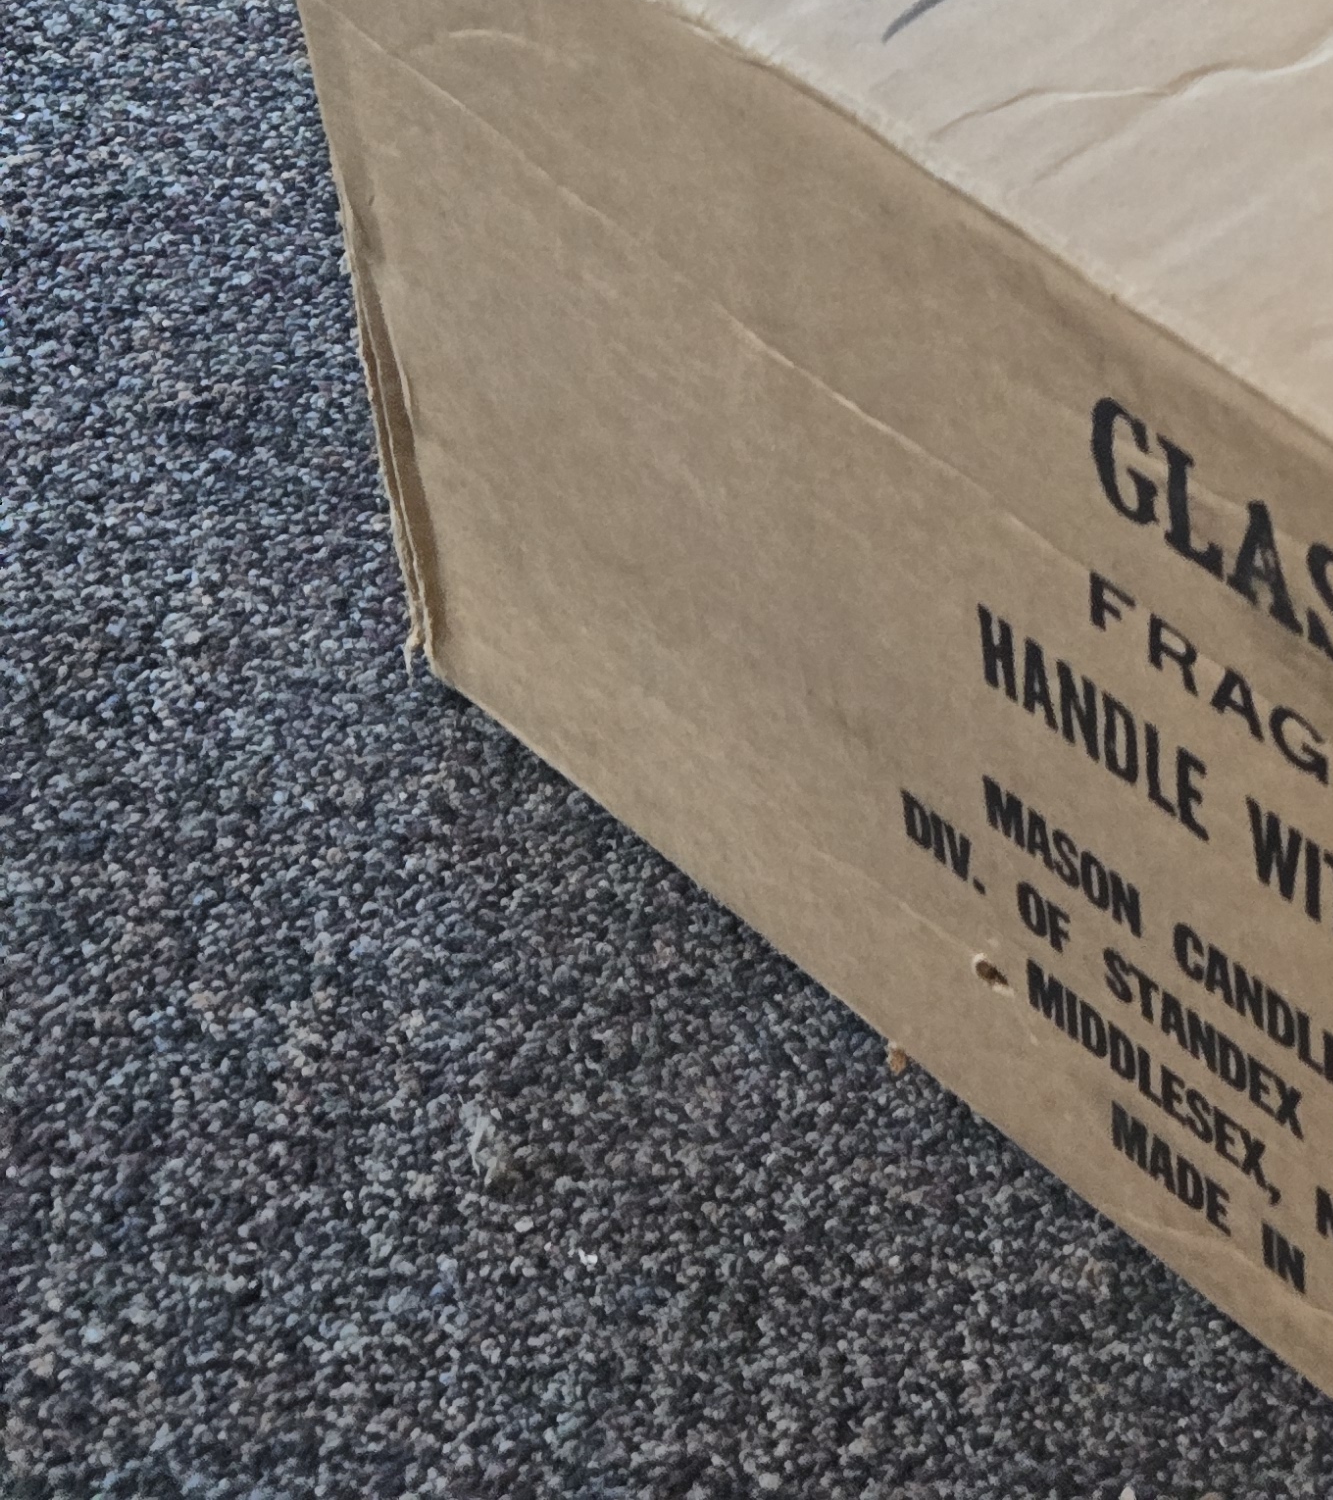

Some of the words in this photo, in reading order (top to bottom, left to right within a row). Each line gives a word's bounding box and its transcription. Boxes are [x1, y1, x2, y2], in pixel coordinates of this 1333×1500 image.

[978, 603, 1209, 842] HANDLE
[900, 788, 986, 895] DIV.
[1016, 880, 1070, 953] OF
[1102, 947, 1303, 1139] STANDEX
[983, 774, 1142, 938] MASON
[1026, 958, 1282, 1206] MIDDLESEX,
[1111, 1101, 1231, 1237] MADE
[1261, 1223, 1307, 1294] IN
